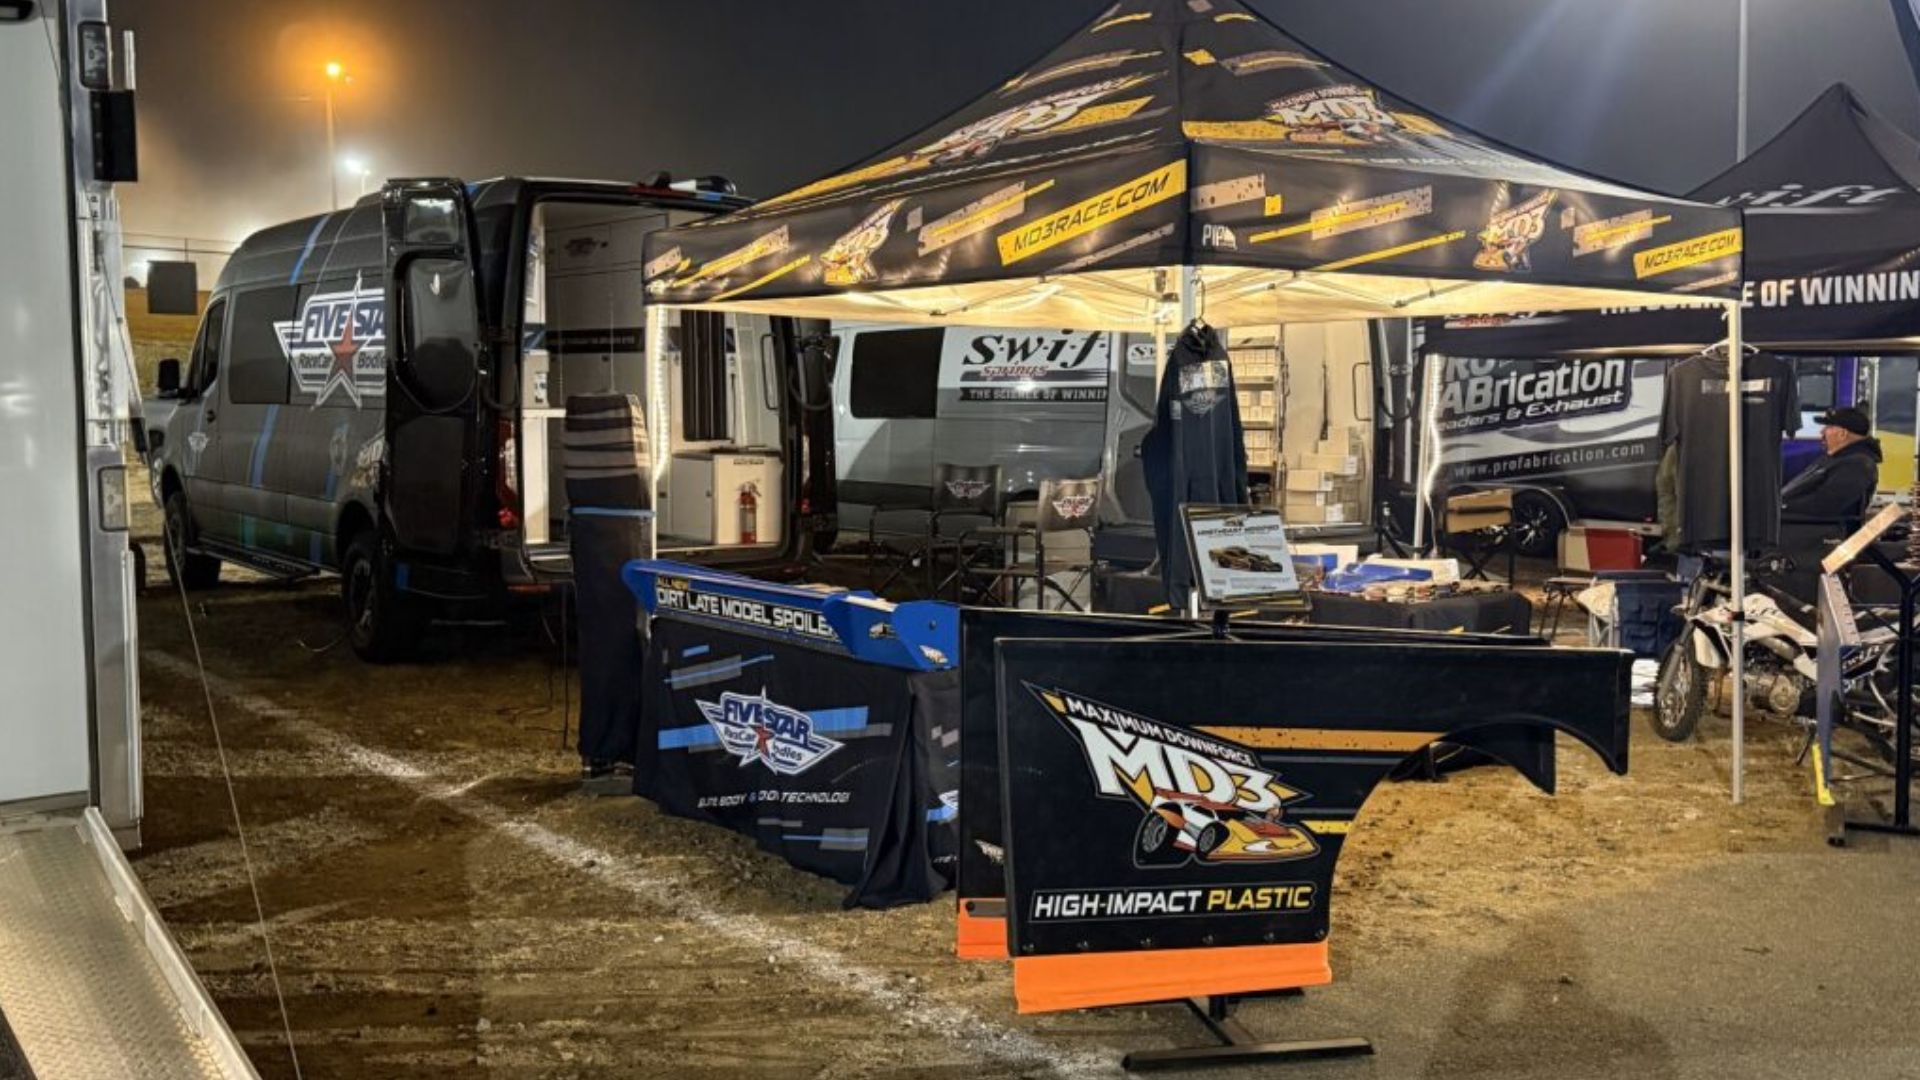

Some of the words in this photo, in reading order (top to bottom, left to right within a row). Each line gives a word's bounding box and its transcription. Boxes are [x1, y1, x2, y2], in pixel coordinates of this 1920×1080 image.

[1760, 279, 1796, 306] OF
[1800, 270, 1920, 306] WINNIN
[355, 301, 385, 337] STA
[1439, 359, 1627, 415] ABrication
[1505, 406, 1522, 421] &
[1525, 390, 1625, 418] Exhaust
[1454, 442, 1646, 477] www.profabrication.com
[657, 587, 684, 608] DIRT
[688, 592, 720, 615] LATE
[722, 597, 772, 625] MODEL
[773, 607, 834, 635] SPOILE
[763, 706, 811, 747] STAR
[1066, 697, 1164, 738] MAXIMUM
[1163, 726, 1256, 767] DOWNFORCE
[1067, 716, 1282, 813] MD3
[1034, 890, 1202, 917] HIGH-IMPACT
[1206, 886, 1313, 910] PLASTIC
